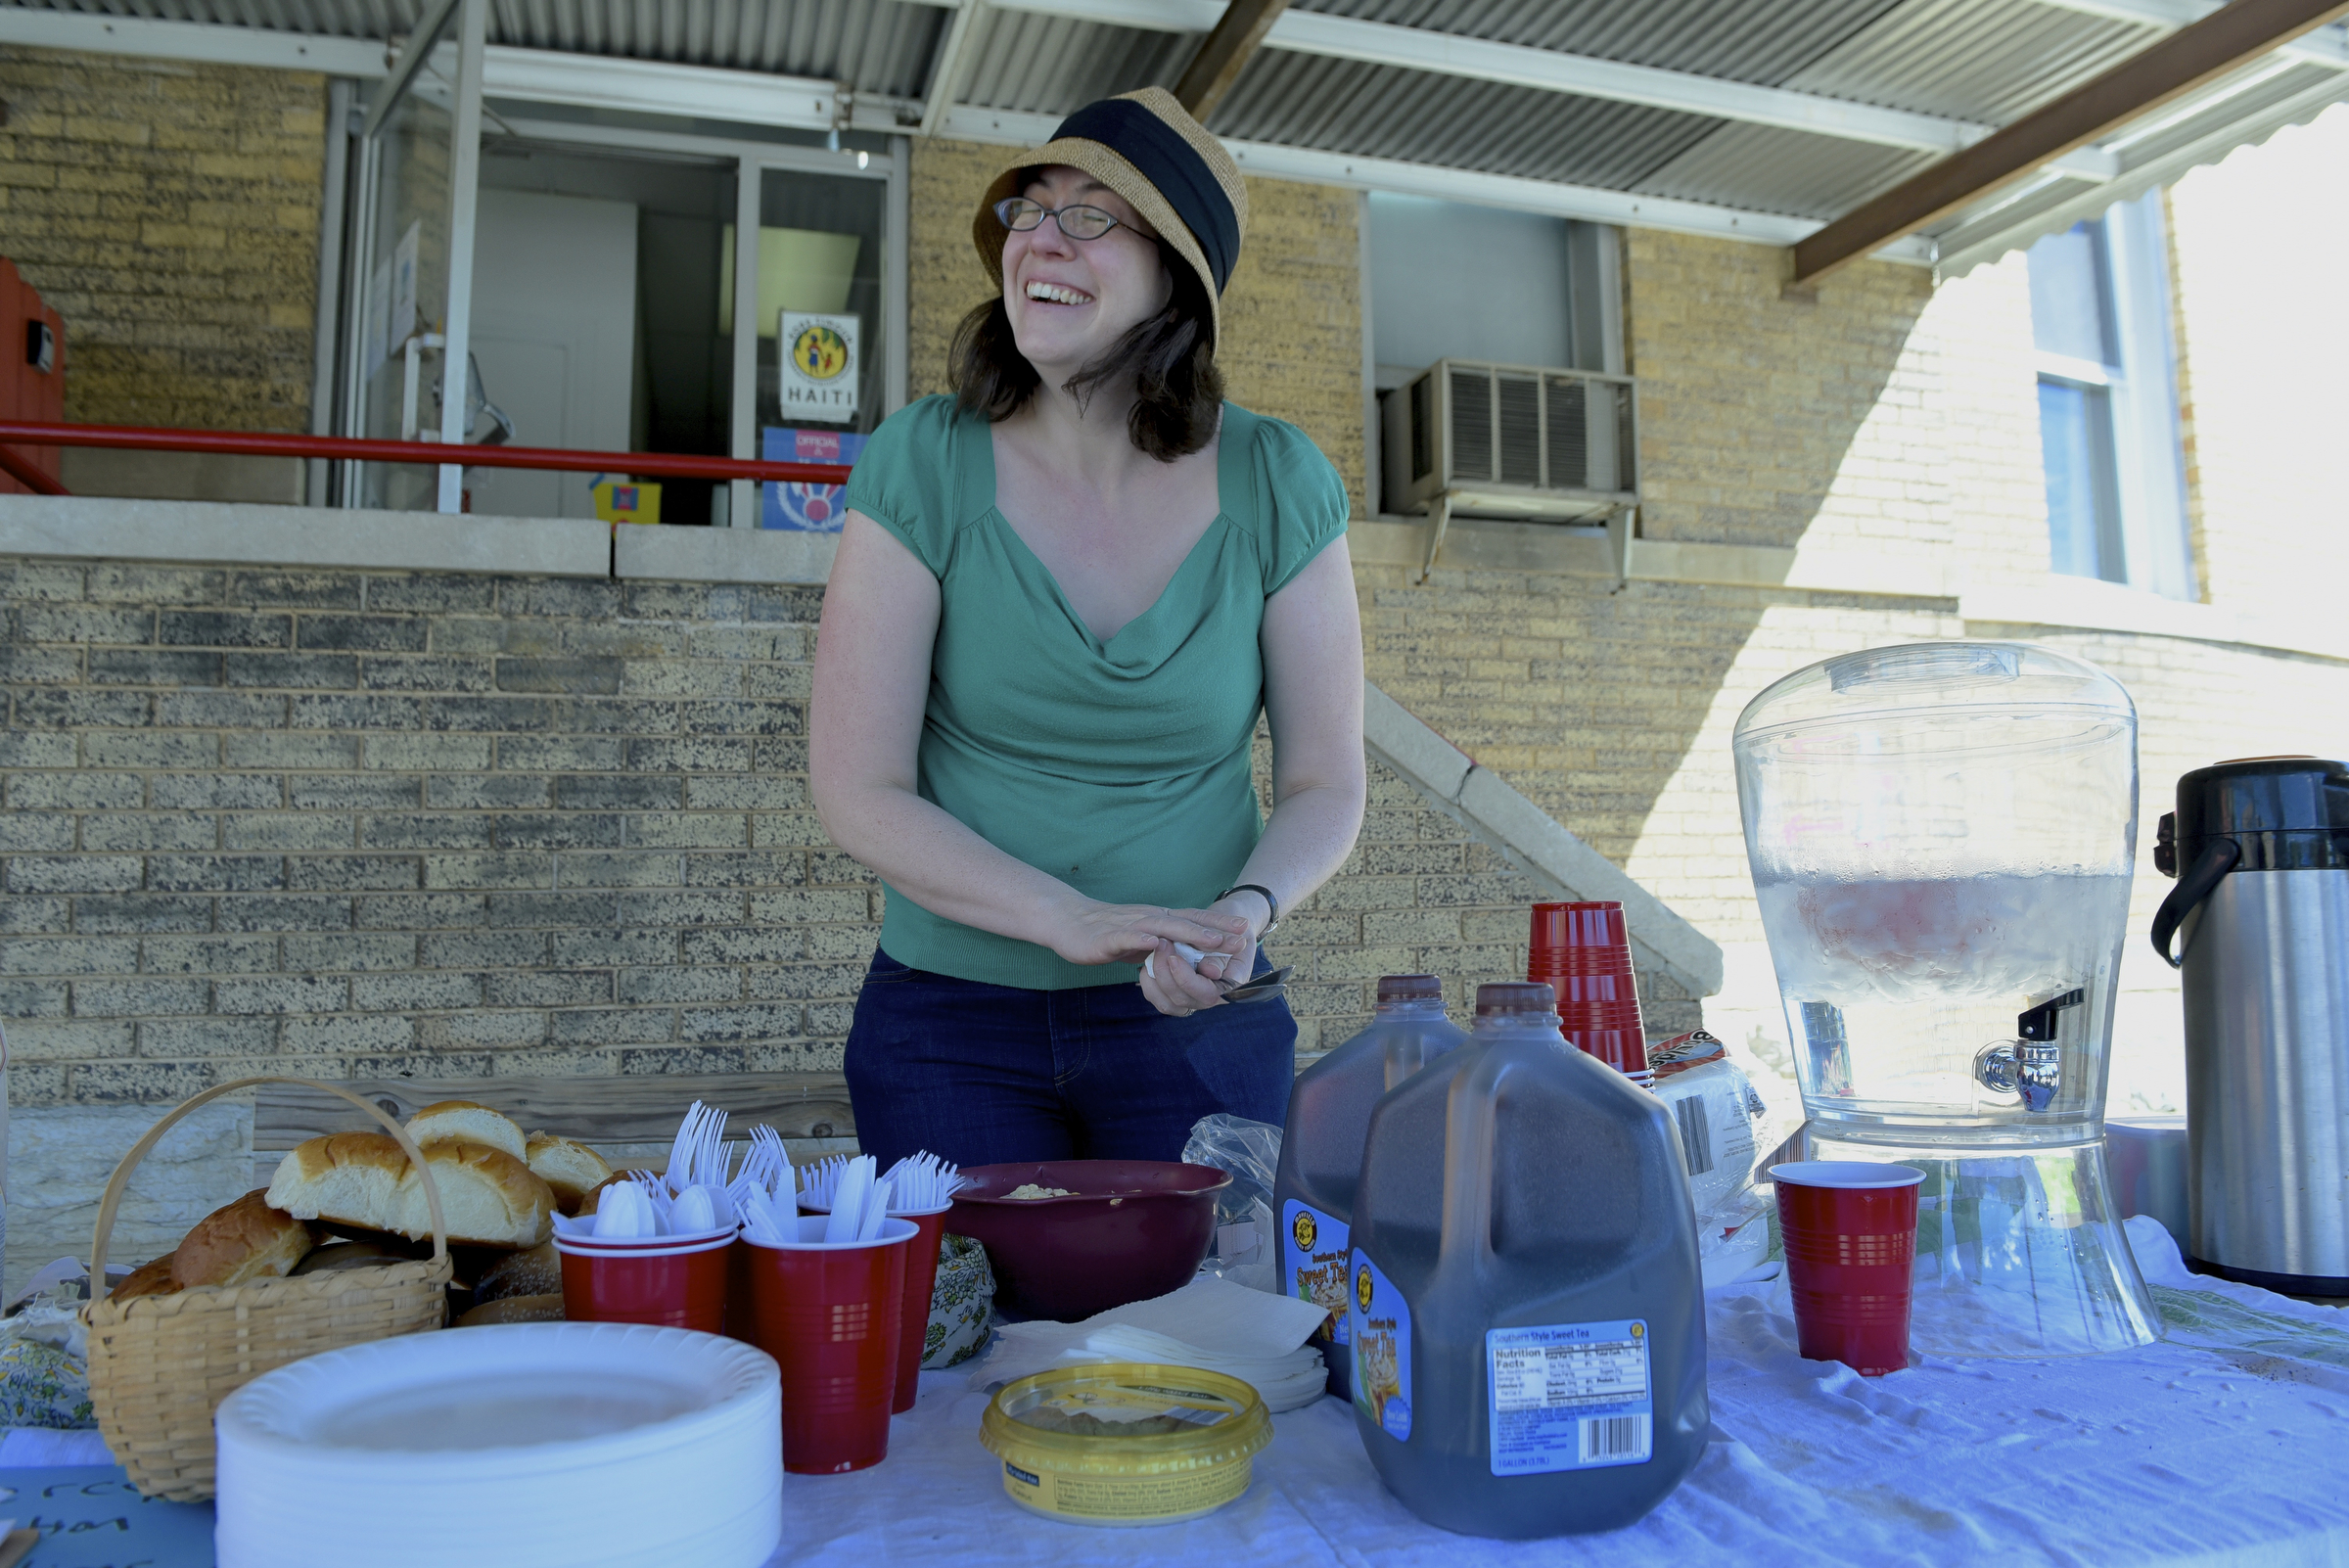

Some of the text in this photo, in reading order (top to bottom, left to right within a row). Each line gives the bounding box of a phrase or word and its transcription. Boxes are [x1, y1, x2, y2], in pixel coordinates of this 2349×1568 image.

[789, 387, 852, 405] HAITI
[796, 435, 840, 448] OFFICIAL
[1648, 1031, 1715, 1070] Boulde
[1313, 1248, 1348, 1264] Southern Styl
[1297, 1265, 1329, 1286] Sweet
[1357, 1330, 1397, 1358] Sweet Tea
[1495, 1328, 1590, 1344] Southern Style Sweet Tea
[1496, 1349, 1542, 1359] Nutrition
[1496, 1360, 1525, 1368] Facts
[1502, 1457, 1527, 1467] GALLON
